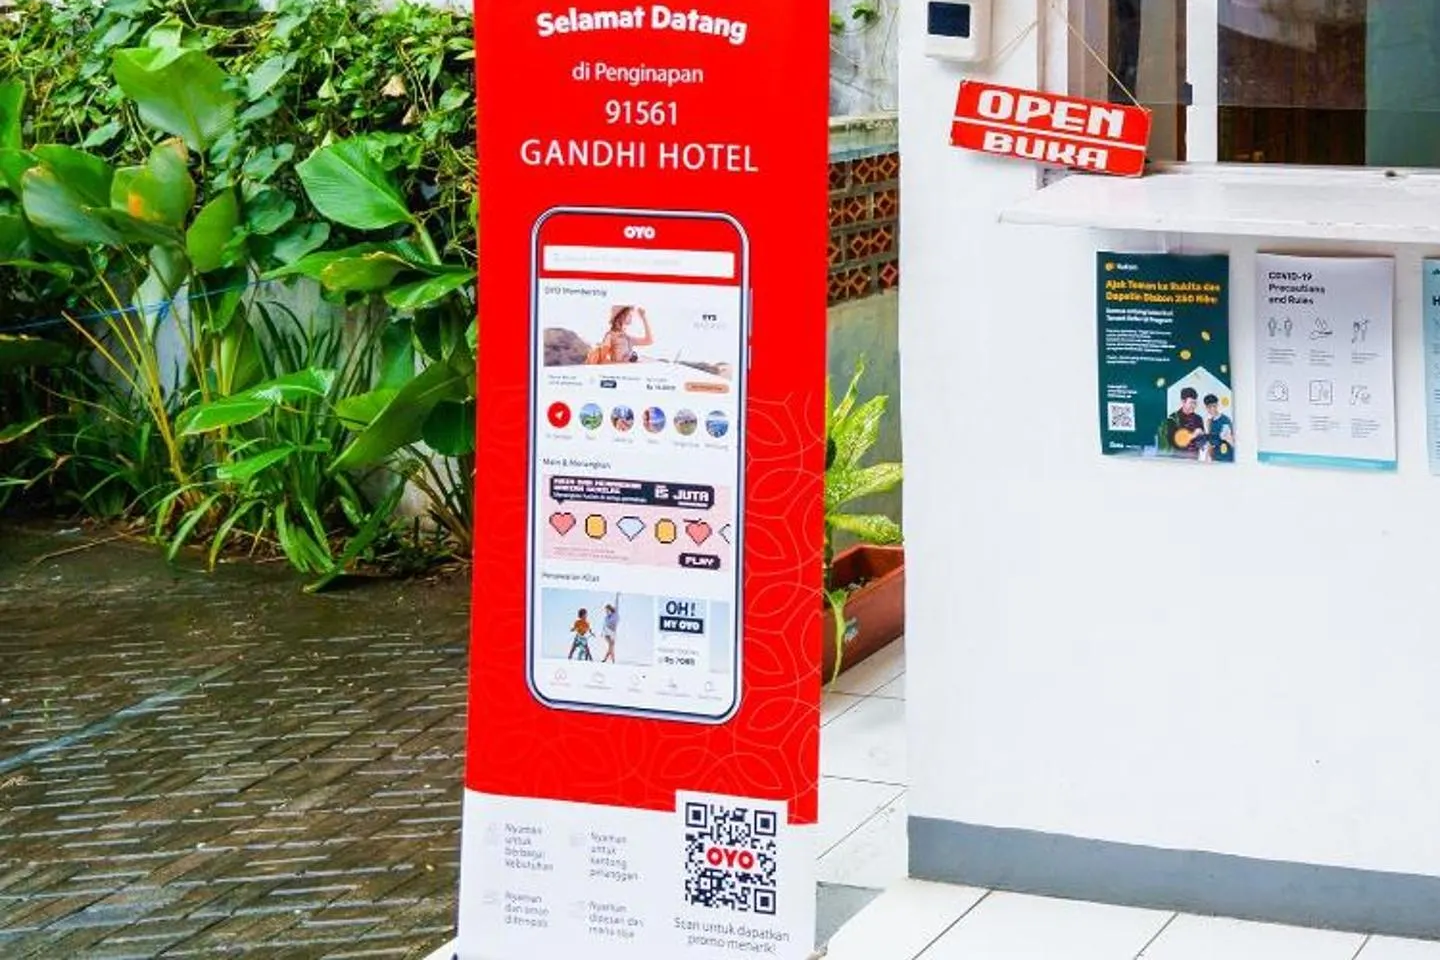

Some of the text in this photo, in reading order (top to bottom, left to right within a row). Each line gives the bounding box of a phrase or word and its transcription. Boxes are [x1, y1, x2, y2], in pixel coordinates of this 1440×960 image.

[536, 5, 747, 44] Selamat Datang
[572, 63, 704, 87] di Penginapan
[605, 100, 677, 126] 91561
[978, 90, 1124, 138] OPEN
[520, 139, 759, 172] GANDHI HOTEL
[982, 131, 1108, 170] BUKA
[624, 226, 656, 239] OYO
[1268, 271, 1312, 281] COVID-19
[1268, 284, 1325, 294] Precautions
[1268, 295, 1314, 304] and Rules
[673, 490, 709, 501] JUTA
[684, 557, 715, 566] PLAY
[665, 600, 696, 617] OH!
[706, 847, 756, 870] OYO
[674, 917, 790, 942] Scan untuk dapatkan
